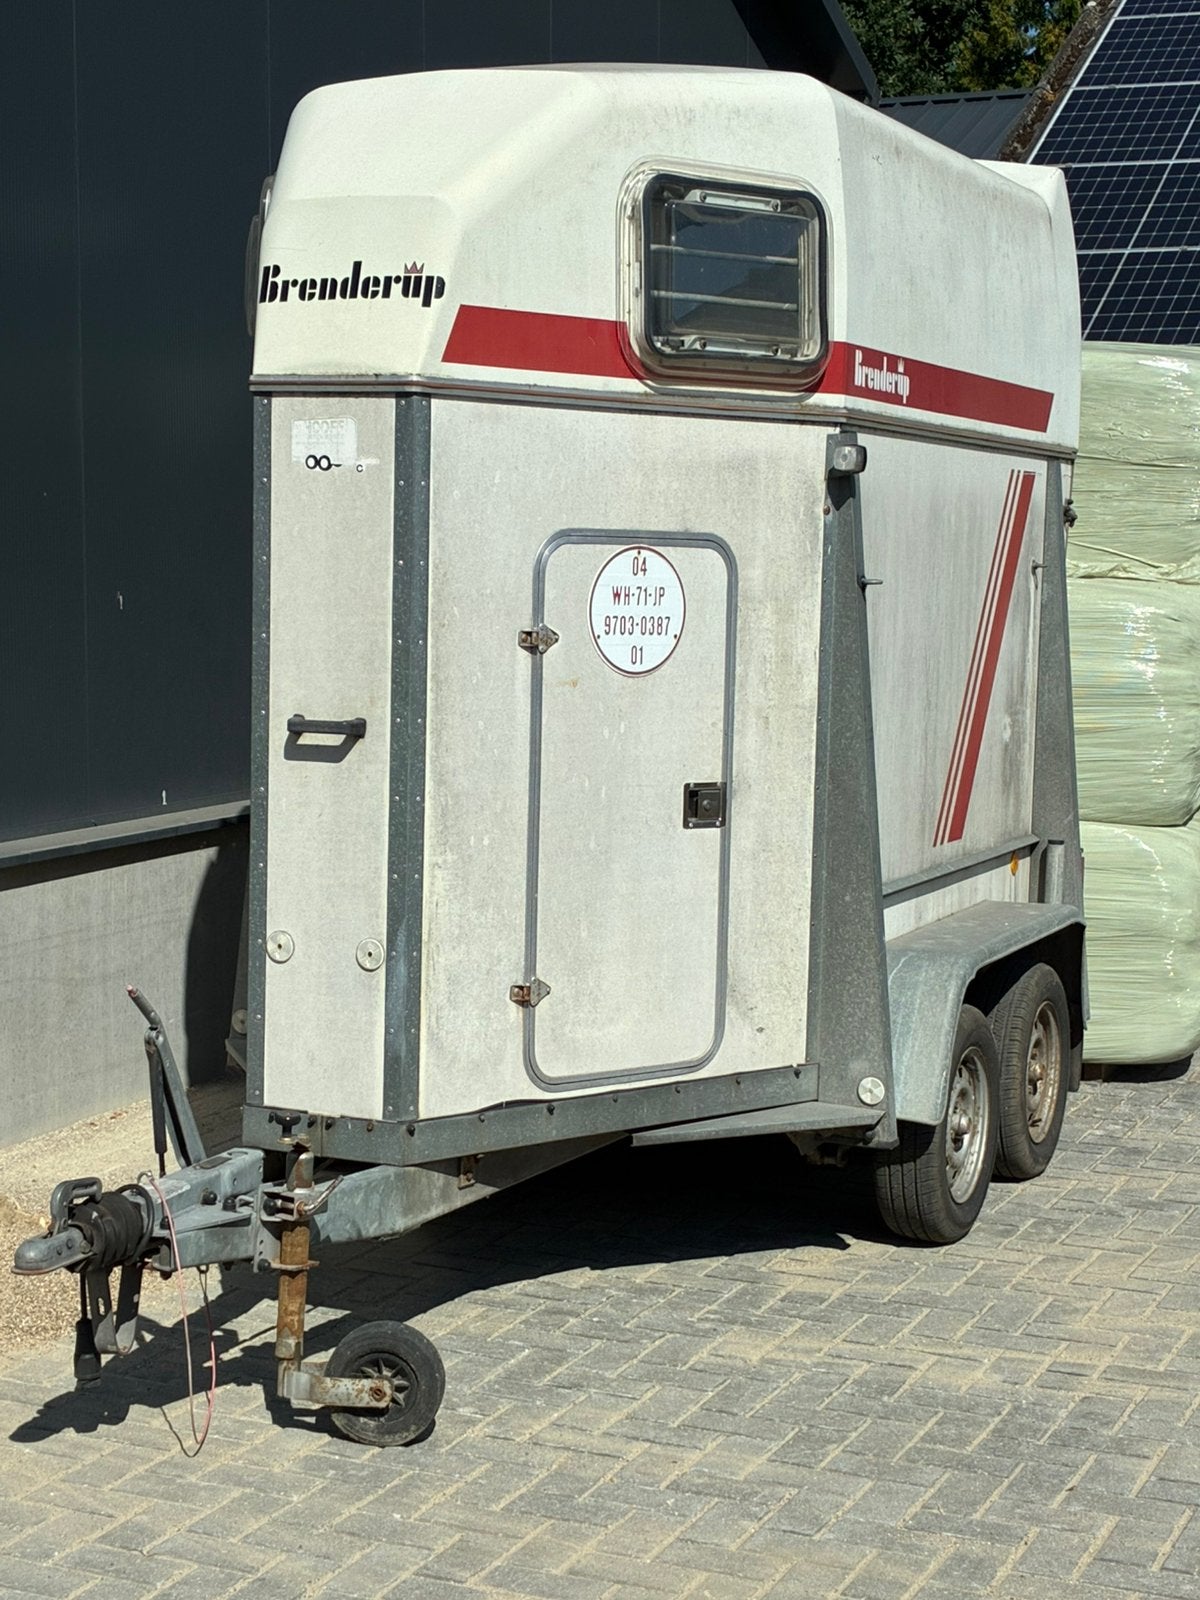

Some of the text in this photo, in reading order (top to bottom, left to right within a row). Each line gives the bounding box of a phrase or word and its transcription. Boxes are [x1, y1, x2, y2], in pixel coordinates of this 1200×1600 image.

[259, 260, 446, 308] Brenderup
[854, 349, 910, 405] Brenderup
[632, 556, 648, 577] 04
[631, 645, 643, 665] 01
